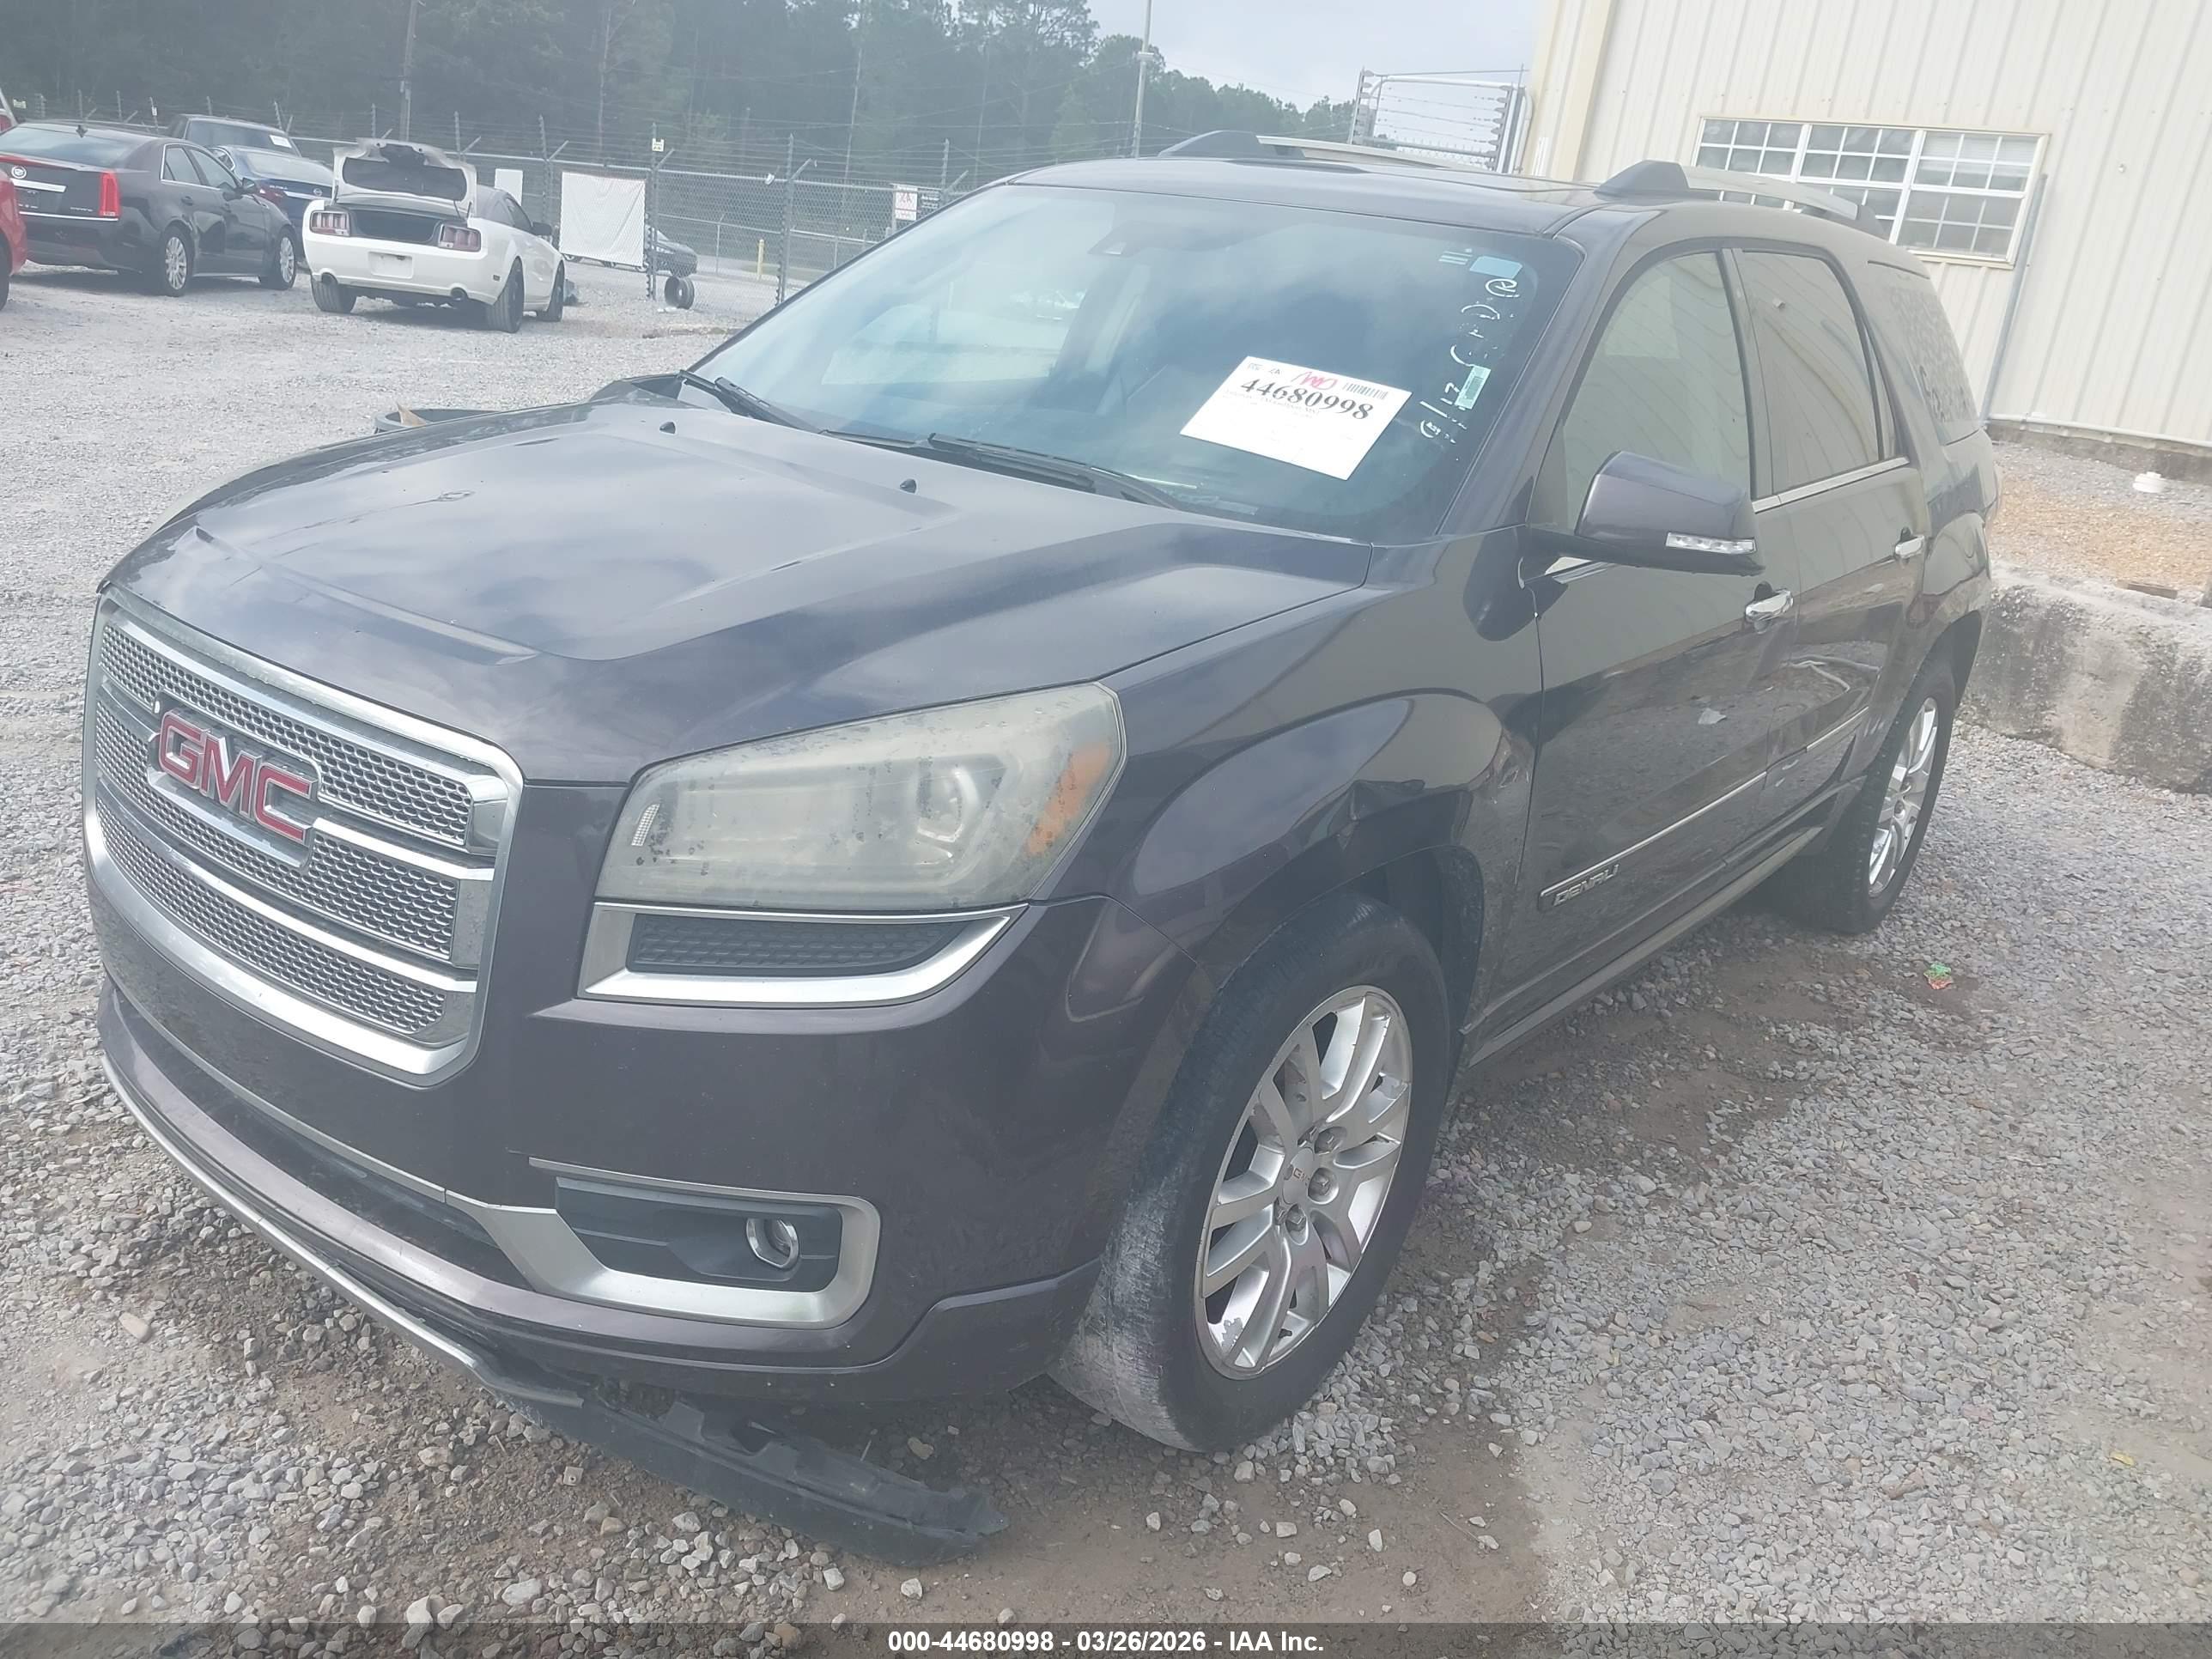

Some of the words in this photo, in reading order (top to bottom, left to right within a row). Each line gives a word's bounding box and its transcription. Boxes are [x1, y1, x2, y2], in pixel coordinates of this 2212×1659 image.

[1241, 379, 1374, 419] 44680998
[158, 709, 318, 845] GMC
[1553, 864, 1620, 906] DENALI
